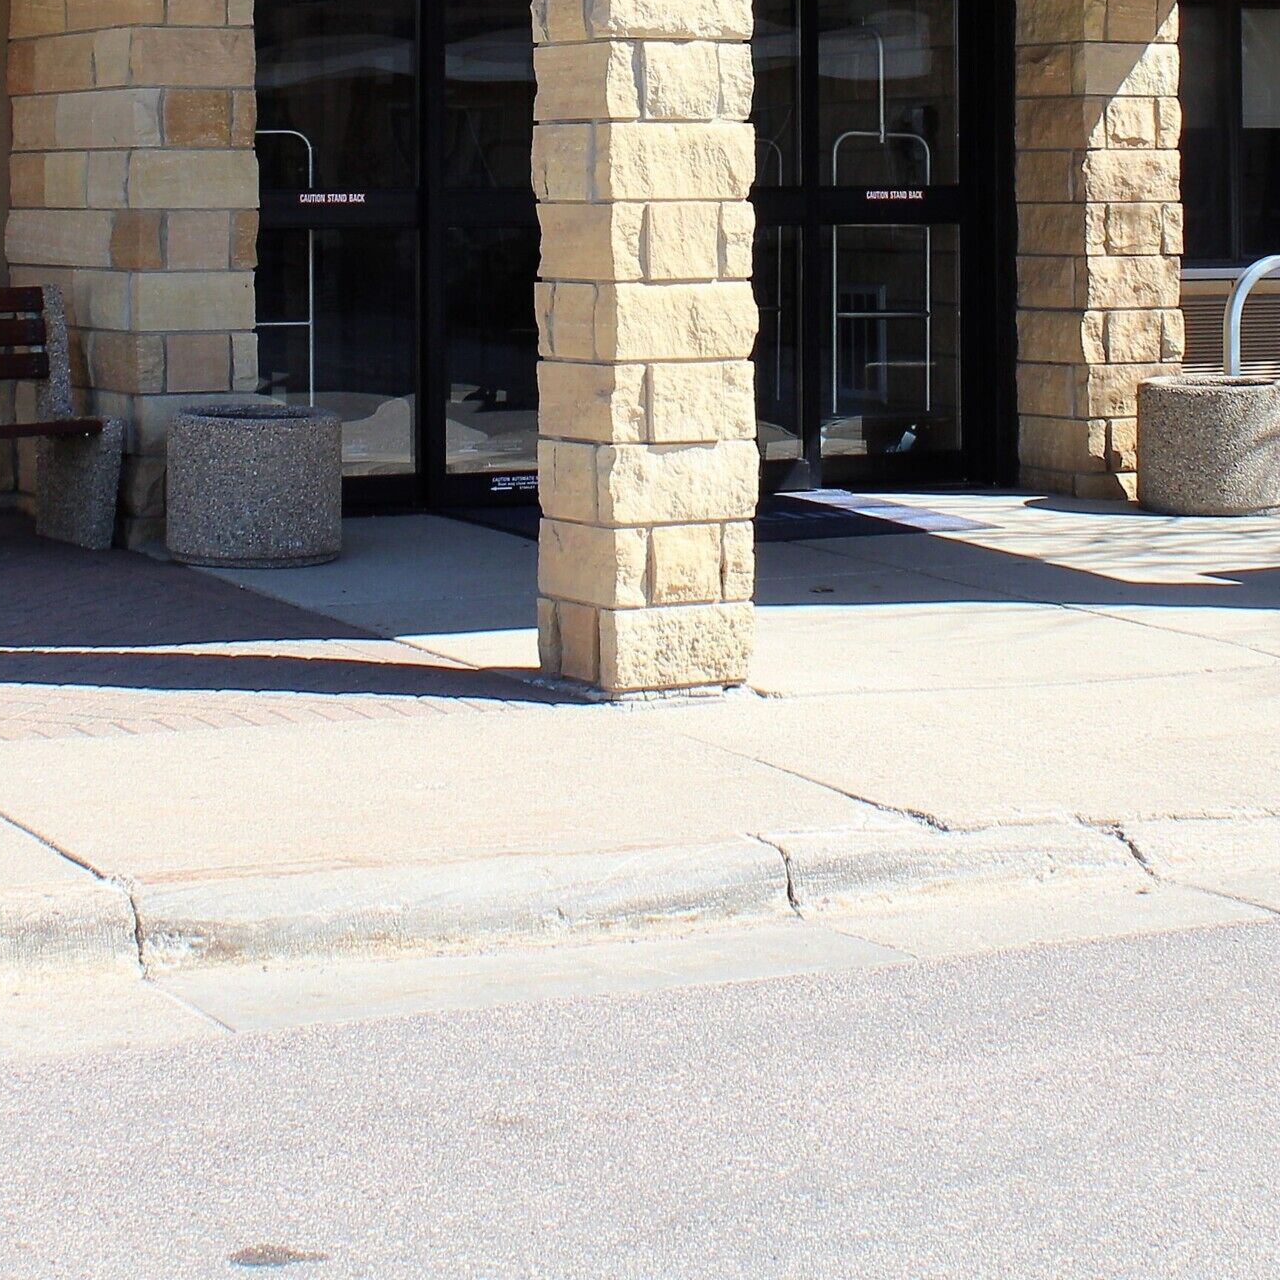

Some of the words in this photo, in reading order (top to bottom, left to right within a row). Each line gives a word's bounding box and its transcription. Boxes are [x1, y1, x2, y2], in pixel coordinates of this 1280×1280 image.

[300, 193, 325, 203] CAUTION
[327, 193, 348, 203] STAND
[349, 193, 365, 203] BACK
[866, 190, 889, 199] CAUTION
[890, 190, 907, 199] STAND
[908, 190, 923, 199] BACK
